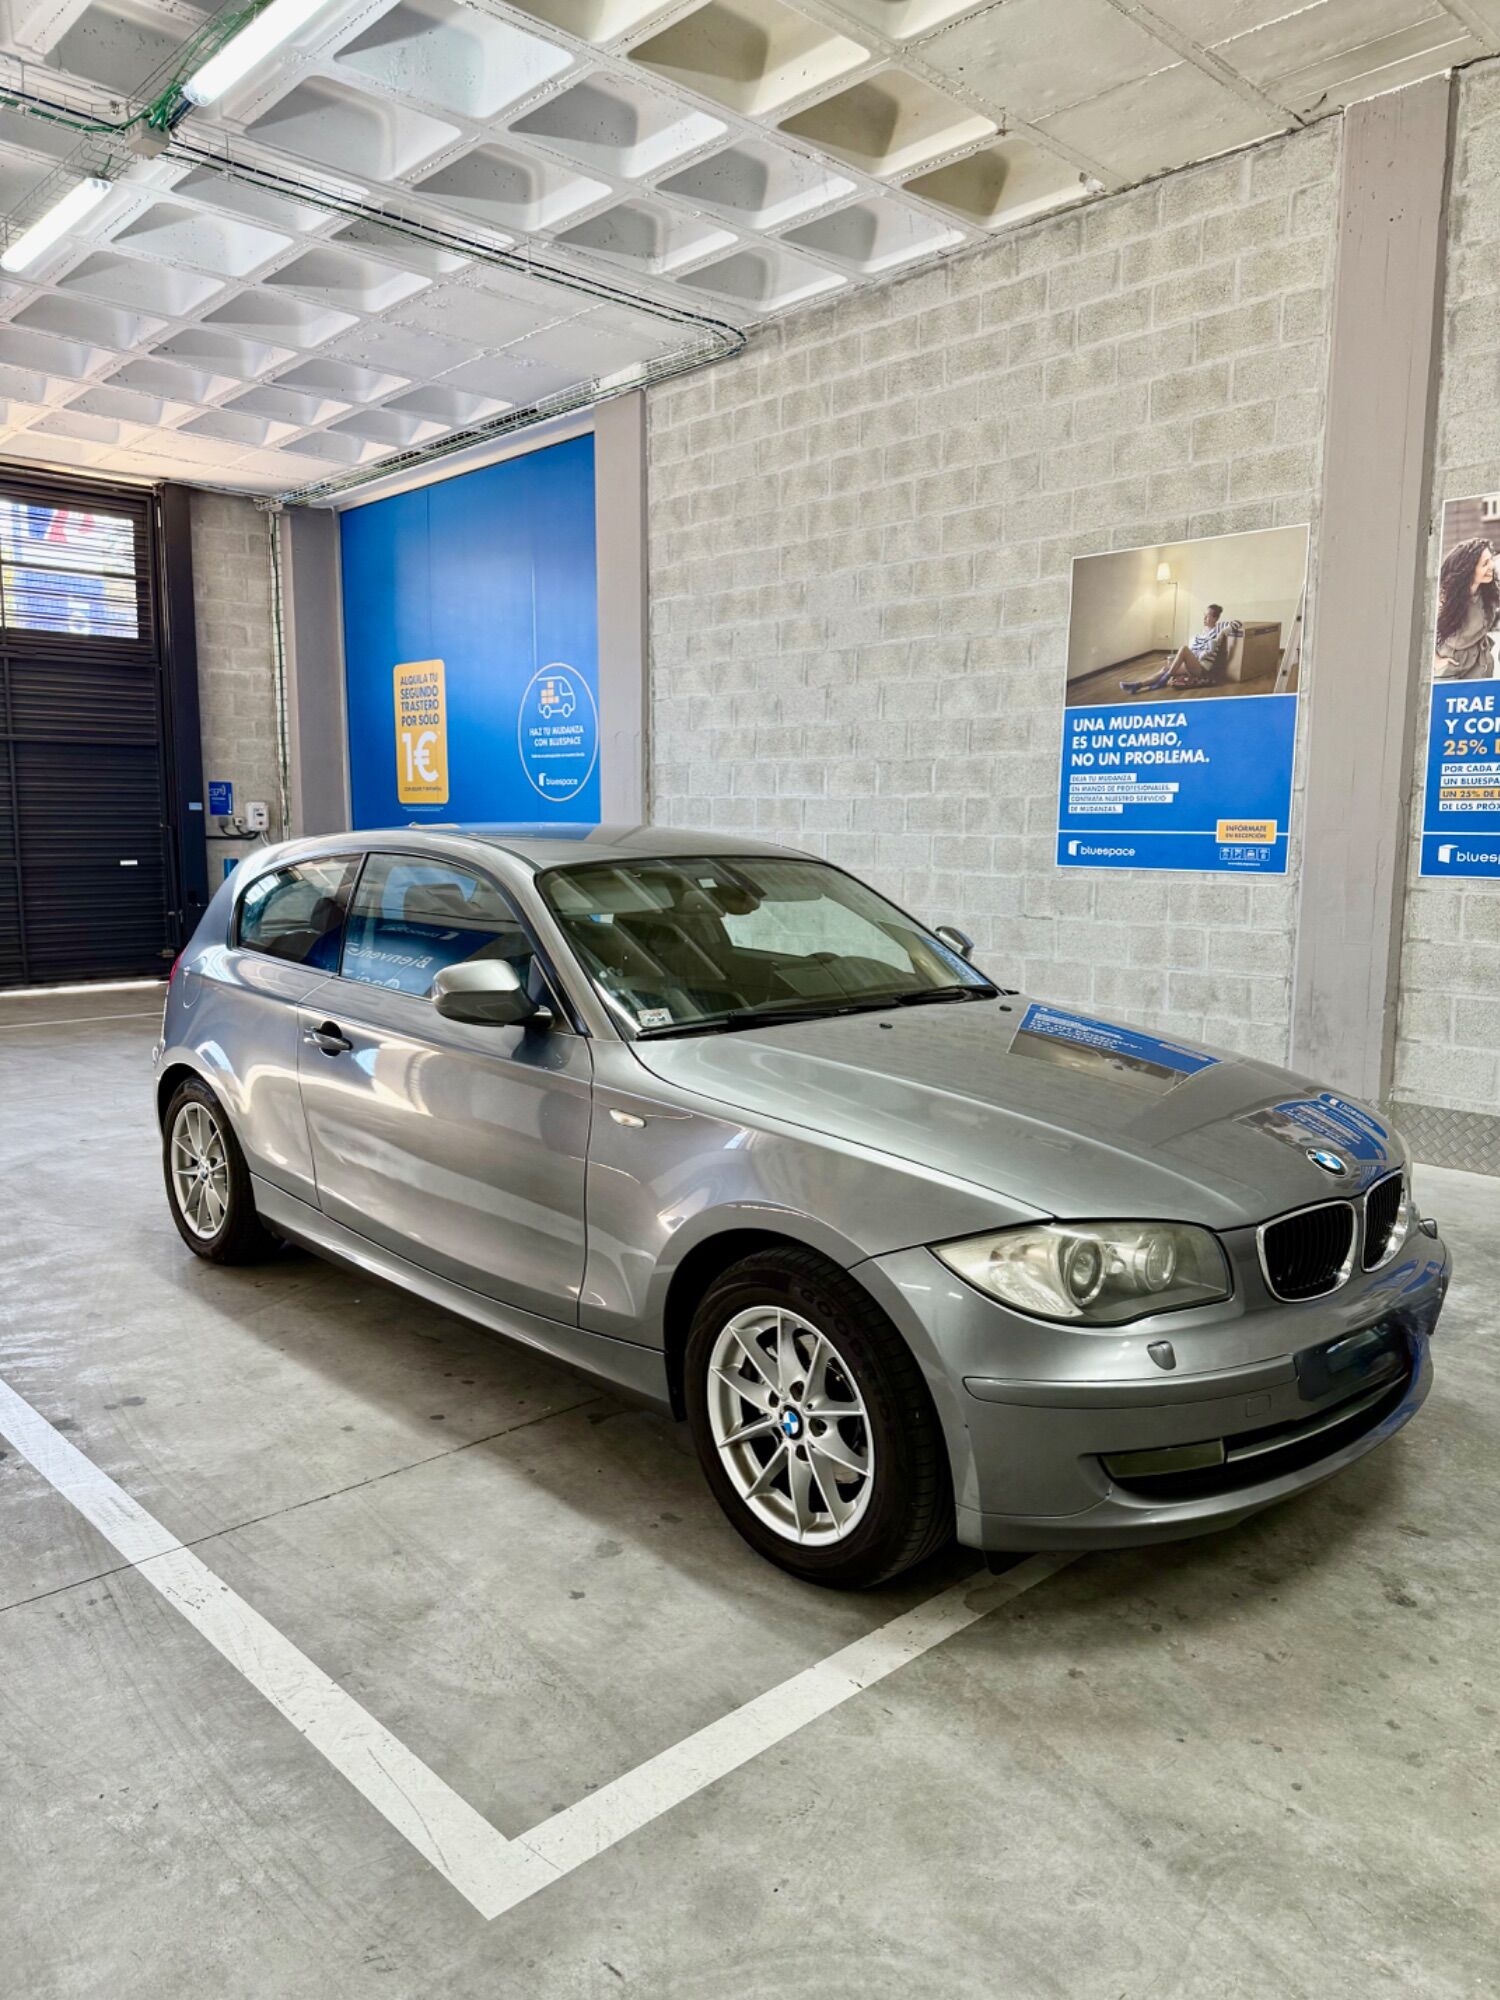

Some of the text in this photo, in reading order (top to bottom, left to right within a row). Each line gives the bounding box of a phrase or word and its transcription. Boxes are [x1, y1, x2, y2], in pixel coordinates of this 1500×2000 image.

[400, 672, 438, 686] ALQUILA TU
[400, 685, 439, 700] SEGUNDO
[400, 698, 440, 713] TRASTERO
[1446, 696, 1495, 714] TRAE
[402, 714, 417, 727] POR
[1074, 712, 1188, 732] UNA MUDANZA
[1444, 719, 1458, 734] Y
[528, 724, 584, 736] HAZ TU MUDANZA
[534, 738, 548, 747] CON
[1072, 731, 1182, 750] ES UN CAMBIO,
[1443, 738, 1488, 756] 25%
[402, 731, 440, 783] 1€
[1072, 749, 1210, 766] NO UN PROBLEMA.
[1080, 845, 1136, 858] bluespace
